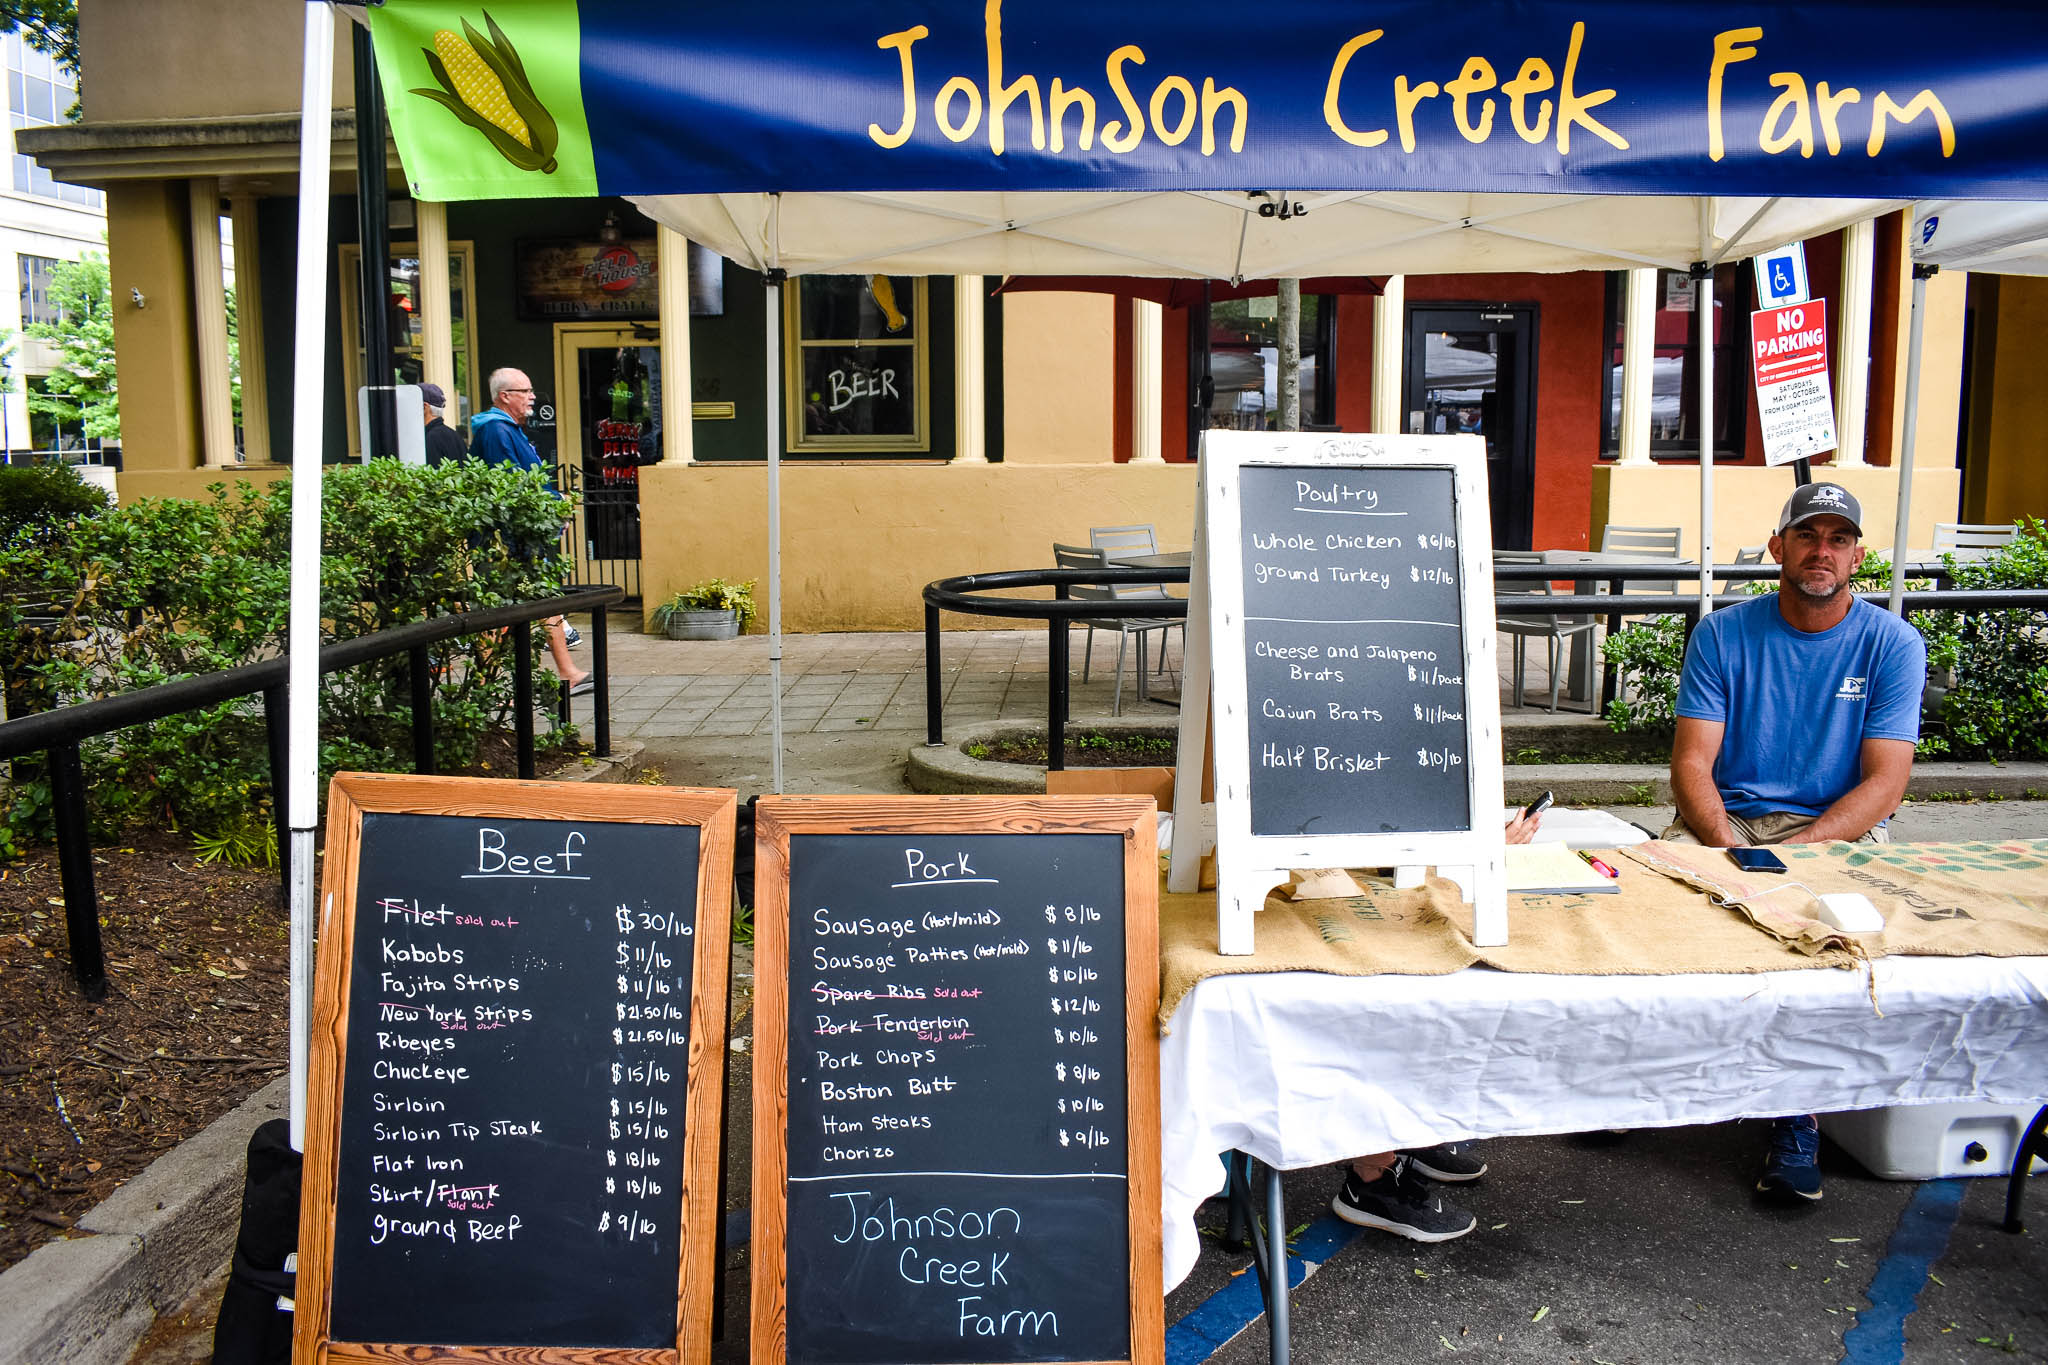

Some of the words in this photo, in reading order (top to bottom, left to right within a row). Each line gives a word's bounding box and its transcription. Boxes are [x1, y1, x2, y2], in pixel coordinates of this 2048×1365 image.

[868, 0, 1248, 156] Johnson
[1324, 21, 1630, 155] Creek
[1707, 27, 1956, 162] Farm
[599, 261, 651, 284] HOUSE
[1777, 308, 1804, 333] NO
[1757, 327, 1823, 358] PARKING
[828, 369, 899, 412] BEER
[1772, 395, 1787, 404] MAY
[1792, 386, 1820, 399] OCTOBER
[1779, 380, 1813, 393] SATURDAYS
[1764, 407, 1780, 415] FROM
[598, 418, 642, 440] JERKY
[603, 442, 641, 459] BEER
[1296, 480, 1378, 509] Poultry
[1253, 533, 1318, 550] Whole
[1326, 534, 1401, 549] Chicken
[1328, 567, 1389, 589] Turkey
[1255, 642, 1320, 659] Cheese
[1327, 645, 1359, 658] and
[1366, 645, 1437, 663] Jalapeno
[1290, 665, 1344, 682] Brats
[1263, 699, 1316, 718] Cajun
[1328, 703, 1382, 721] Brats
[1262, 743, 1304, 768] Half
[1313, 747, 1391, 772] Brisket
[478, 827, 586, 874] Beef
[905, 848, 977, 880] Pork
[383, 898, 454, 925] Filet
[491, 917, 519, 929] out
[813, 908, 917, 938] Sausage
[382, 938, 464, 964] Kabobs
[813, 947, 896, 974] Sausage
[905, 947, 968, 963] Patties
[381, 973, 446, 998] Fajita
[454, 974, 520, 992] Strips
[813, 981, 876, 1006] Spare
[887, 984, 926, 1000] Ribs
[961, 988, 982, 998] out
[379, 1004, 418, 1022] New
[426, 1003, 466, 1021] York
[474, 1006, 532, 1023] Strips
[817, 1015, 862, 1035] Pork
[873, 1013, 969, 1033] Tenderloin
[477, 1022, 506, 1031] out
[948, 1031, 975, 1040] out
[377, 1032, 456, 1055] Ribeyes
[817, 1050, 863, 1069] Pork
[876, 1049, 936, 1067] Chops
[373, 1061, 470, 1084] Chuckeye
[821, 1081, 892, 1101] Boston
[908, 1076, 957, 1095] Butt
[373, 1092, 445, 1113] Sirloin
[373, 1122, 440, 1142] Sirloin
[448, 1123, 480, 1141] Tip
[823, 1116, 863, 1134] Ham
[373, 1155, 414, 1172] Flat
[427, 1155, 464, 1171] Iron
[823, 1147, 895, 1161] Chorizo
[472, 1201, 494, 1210] out
[829, 1191, 1021, 1243] Johnson
[469, 1214, 523, 1241] Beef
[899, 1247, 1010, 1287] Creek
[958, 1296, 1058, 1337] Farm
